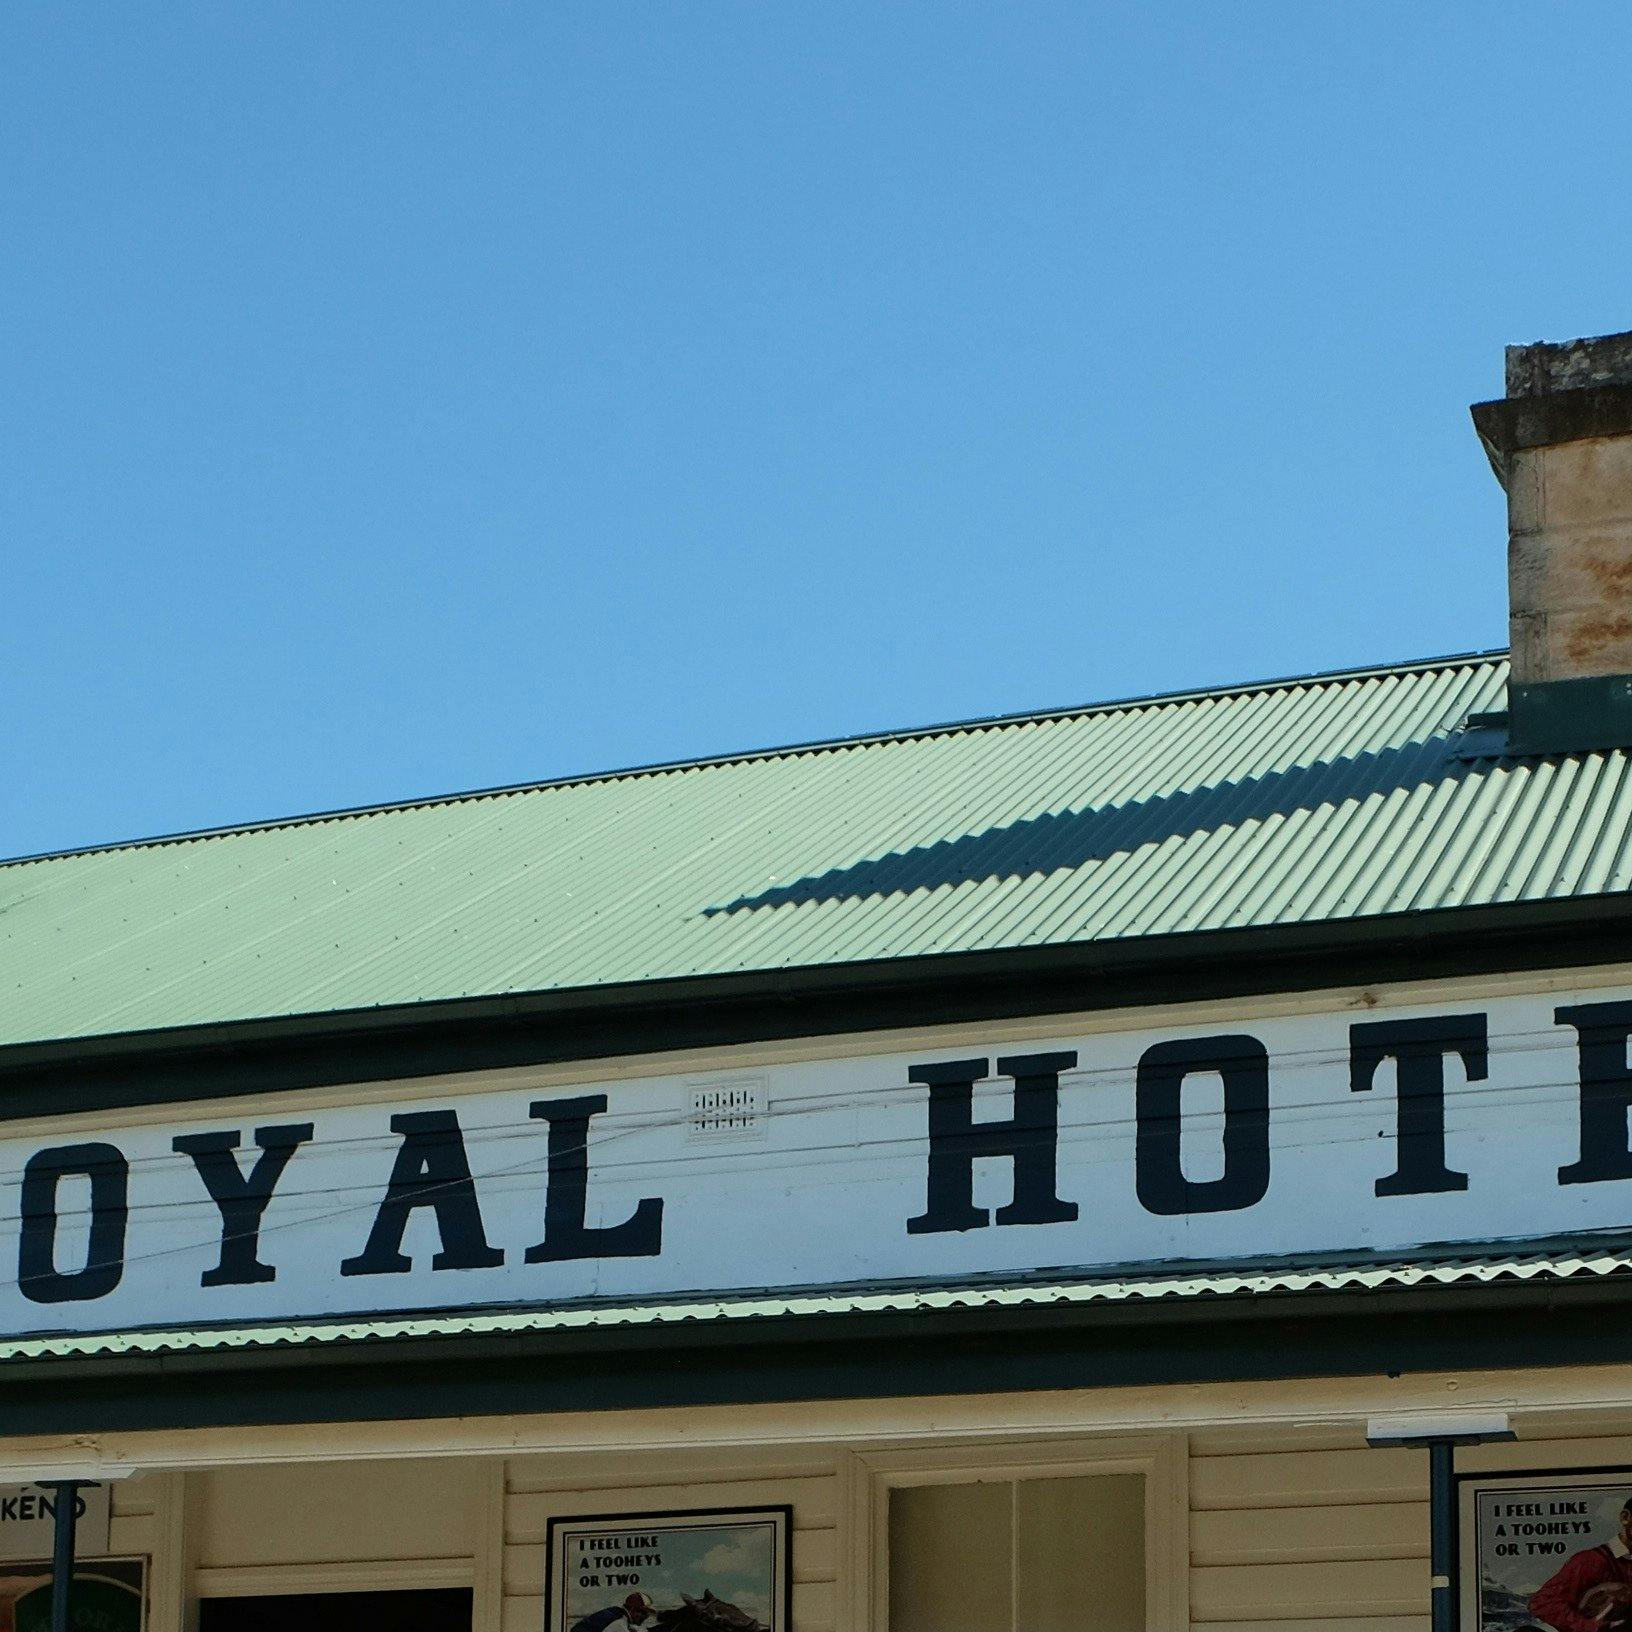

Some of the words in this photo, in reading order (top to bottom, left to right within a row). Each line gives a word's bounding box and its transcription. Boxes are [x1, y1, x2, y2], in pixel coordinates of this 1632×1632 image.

[1494, 1504, 1500, 1517] I
[1506, 1503, 1543, 1517] FEEL
[1549, 1501, 1588, 1515] LIKE
[1495, 1524, 1507, 1537] A
[1511, 1521, 1592, 1536] TOOHEYS
[579, 1539, 585, 1551] I
[590, 1538, 622, 1551] FEEL
[626, 1535, 659, 1549] LIKE
[1495, 1543, 1520, 1556] OR
[1525, 1541, 1567, 1555] TWO
[580, 1557, 590, 1569] A
[594, 1554, 662, 1569] TOOHEYS
[579, 1575, 600, 1588] OR
[605, 1573, 640, 1587] TWO
